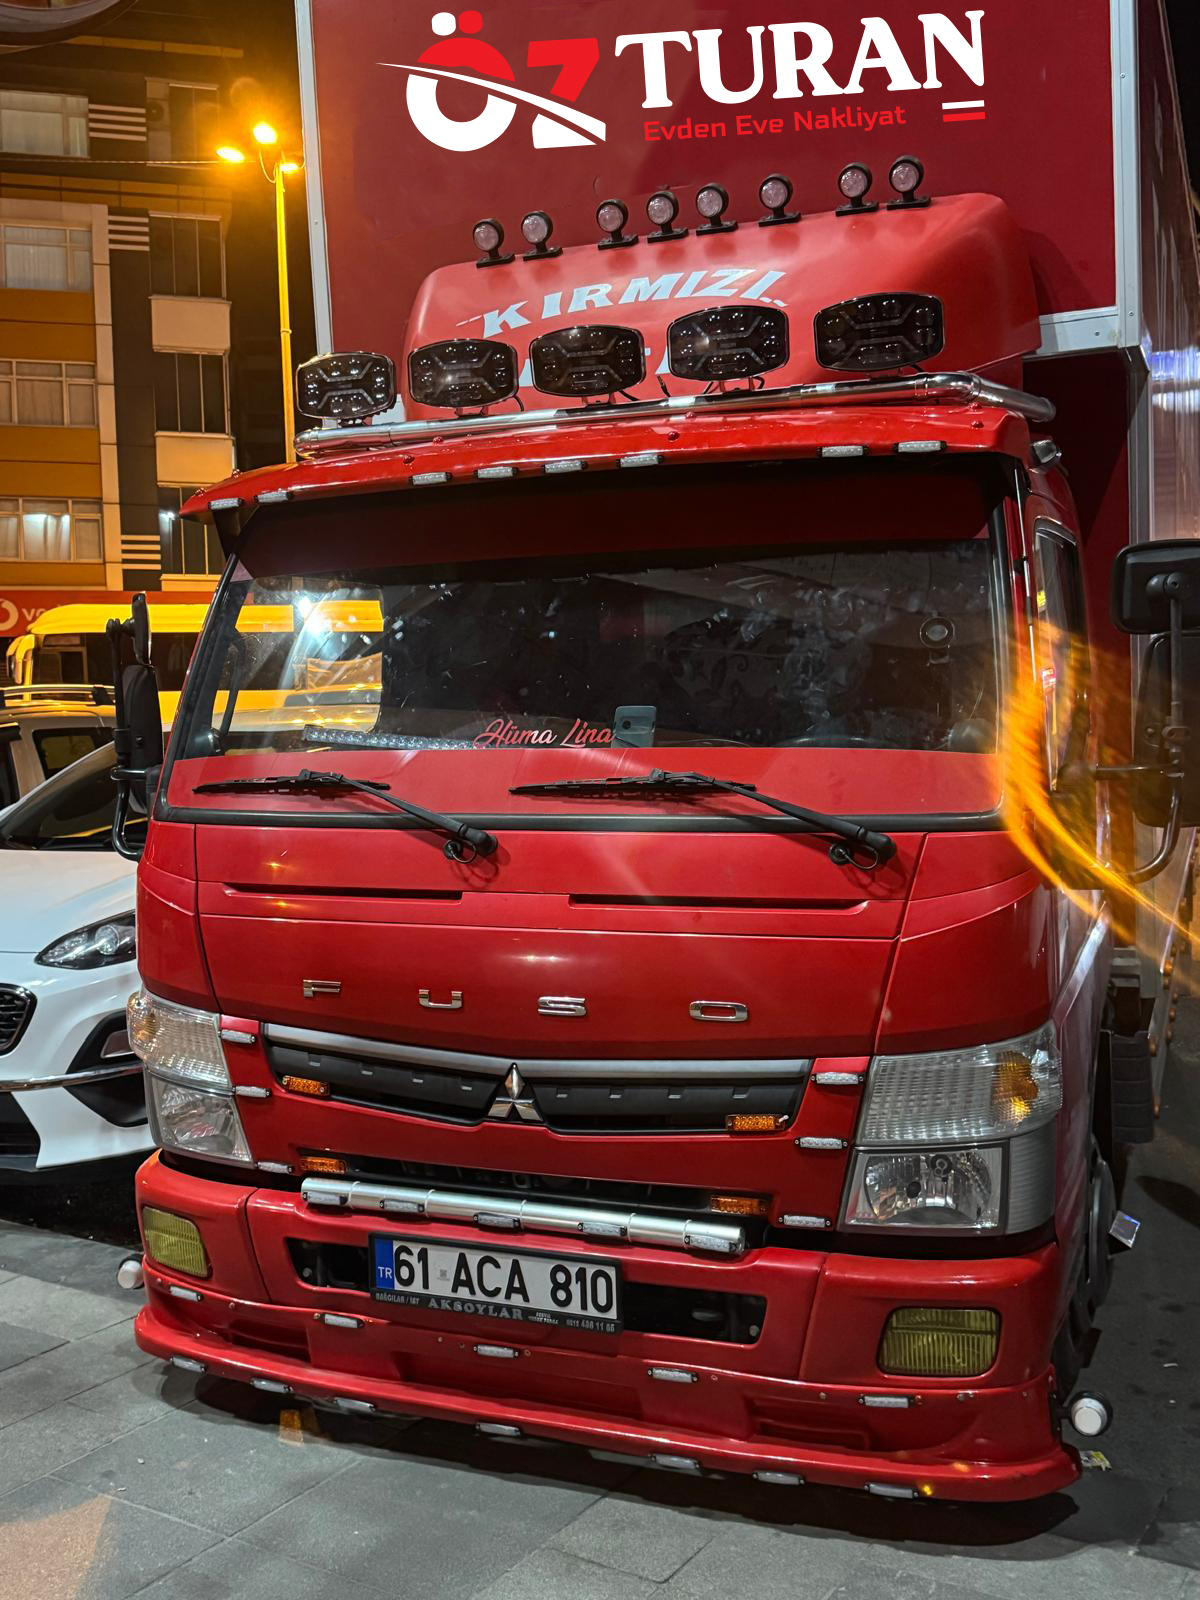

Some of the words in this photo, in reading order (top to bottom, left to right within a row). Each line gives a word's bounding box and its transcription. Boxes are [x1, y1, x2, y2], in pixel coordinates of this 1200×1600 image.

[560, 718, 616, 749] Lina
[302, 979, 749, 1023] FUSO
[378, 1266, 393, 1280] TR
[394, 1244, 430, 1291] 61
[451, 1252, 530, 1304] ACA
[550, 1263, 614, 1314] 810
[428, 1298, 524, 1322] AKSOYLAR
